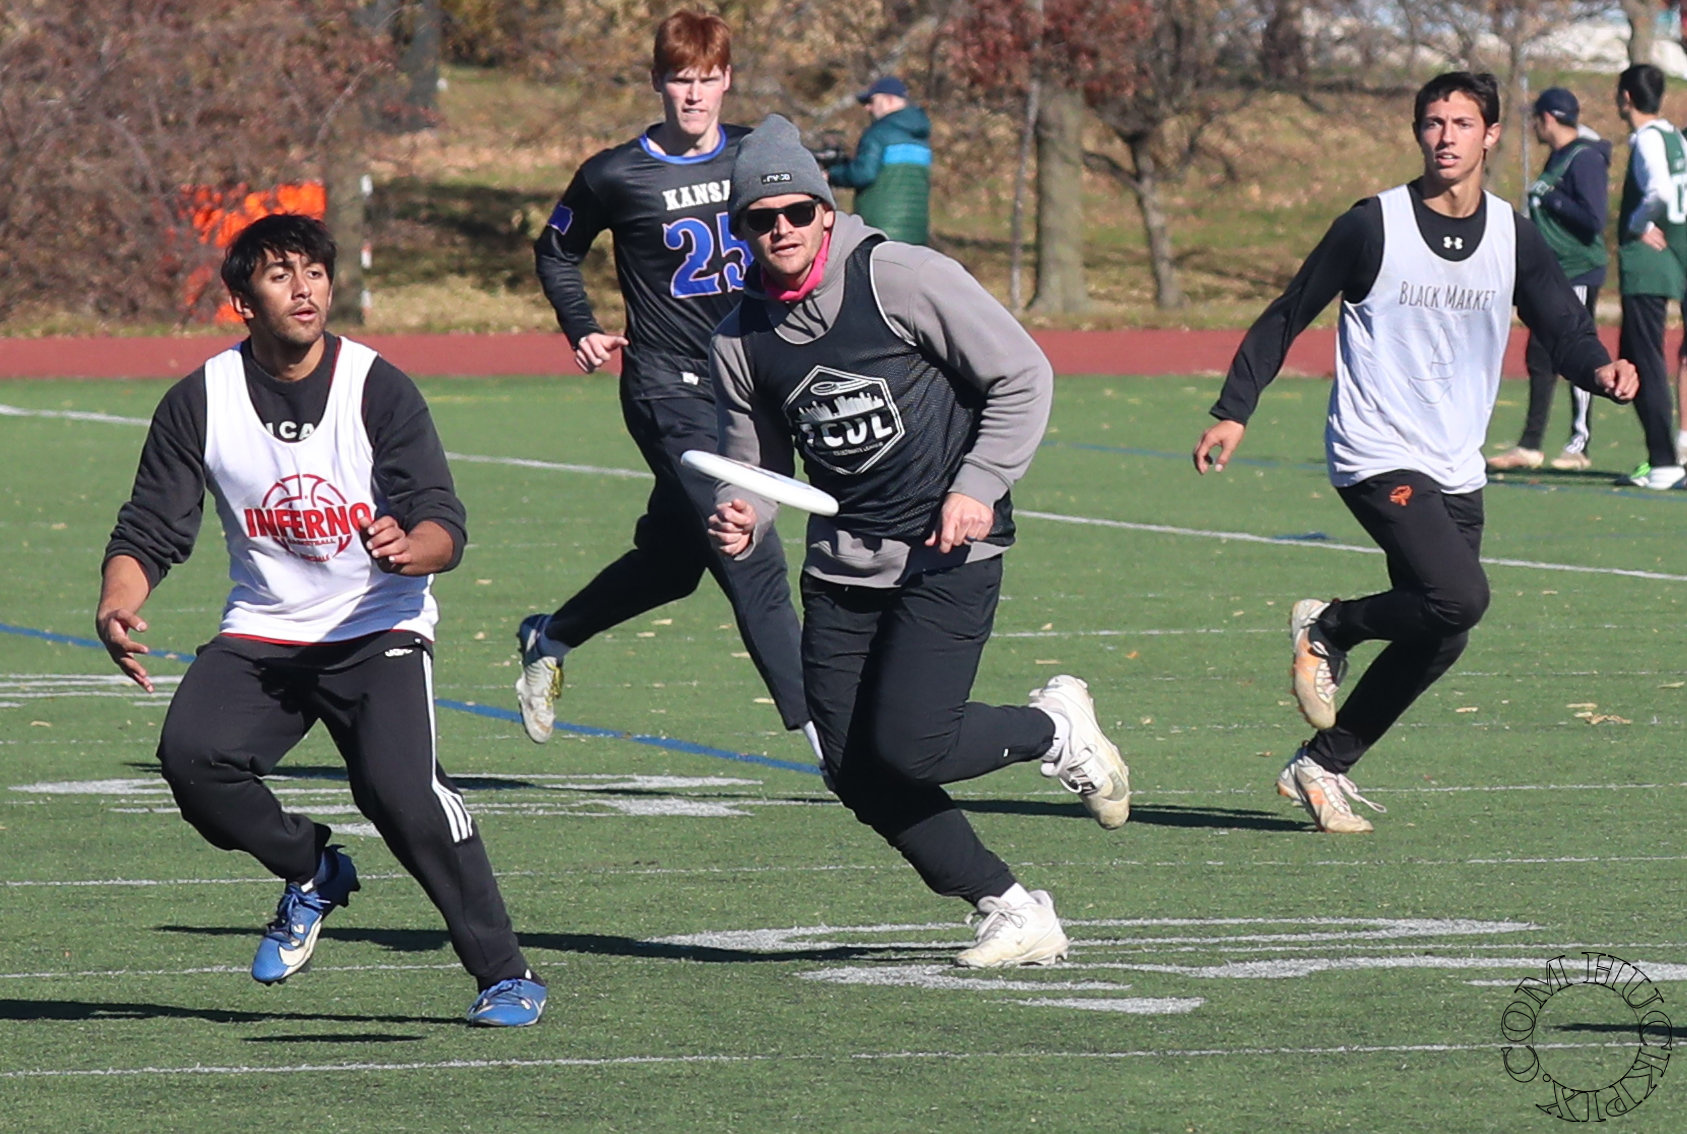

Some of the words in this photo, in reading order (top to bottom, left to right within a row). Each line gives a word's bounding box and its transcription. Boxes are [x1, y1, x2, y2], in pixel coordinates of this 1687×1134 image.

[662, 211, 755, 299] 25
[1399, 280, 1441, 308] BLACK
[1443, 284, 1497, 312] MARKET
[243, 502, 373, 539] INFERNO
